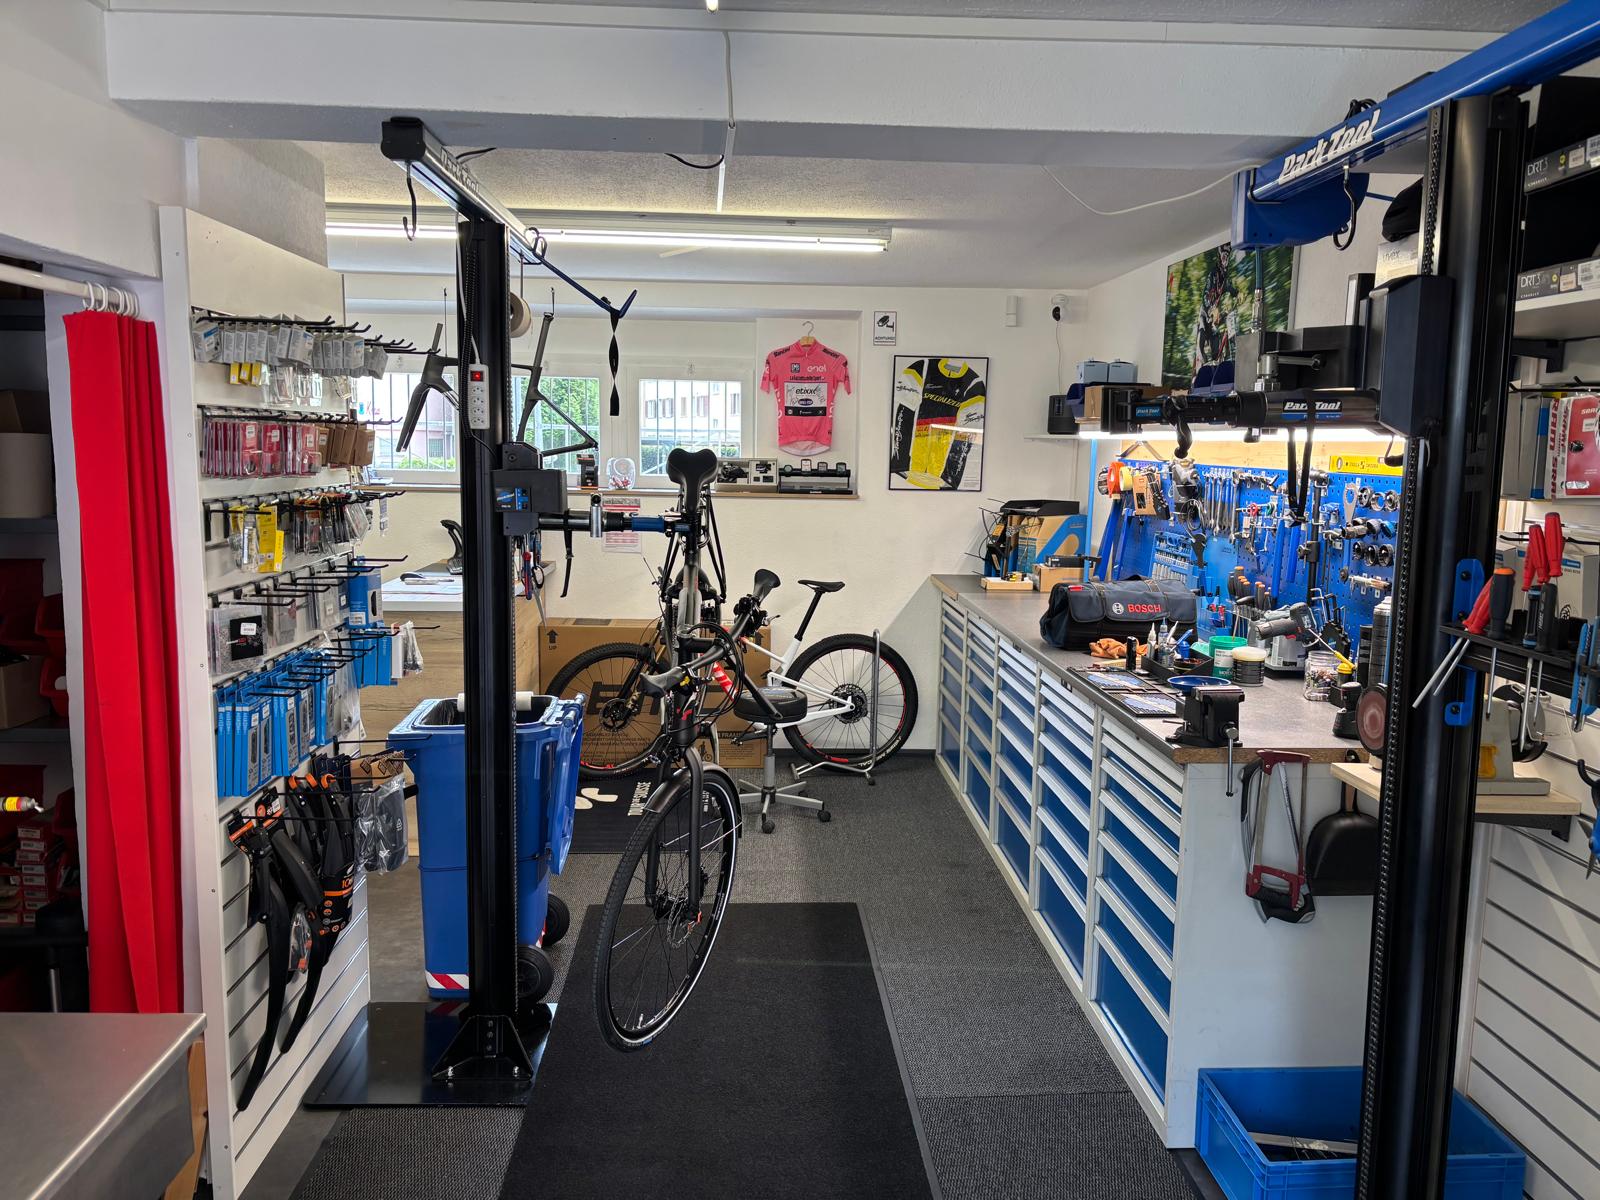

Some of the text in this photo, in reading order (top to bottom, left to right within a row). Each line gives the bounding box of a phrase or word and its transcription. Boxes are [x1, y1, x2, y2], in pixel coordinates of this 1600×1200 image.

[1278, 109, 1381, 186] Park Tool
[807, 364, 827, 373] enel
[1284, 401, 1341, 411] Par Tool
[1127, 603, 1162, 613] BOSCH
